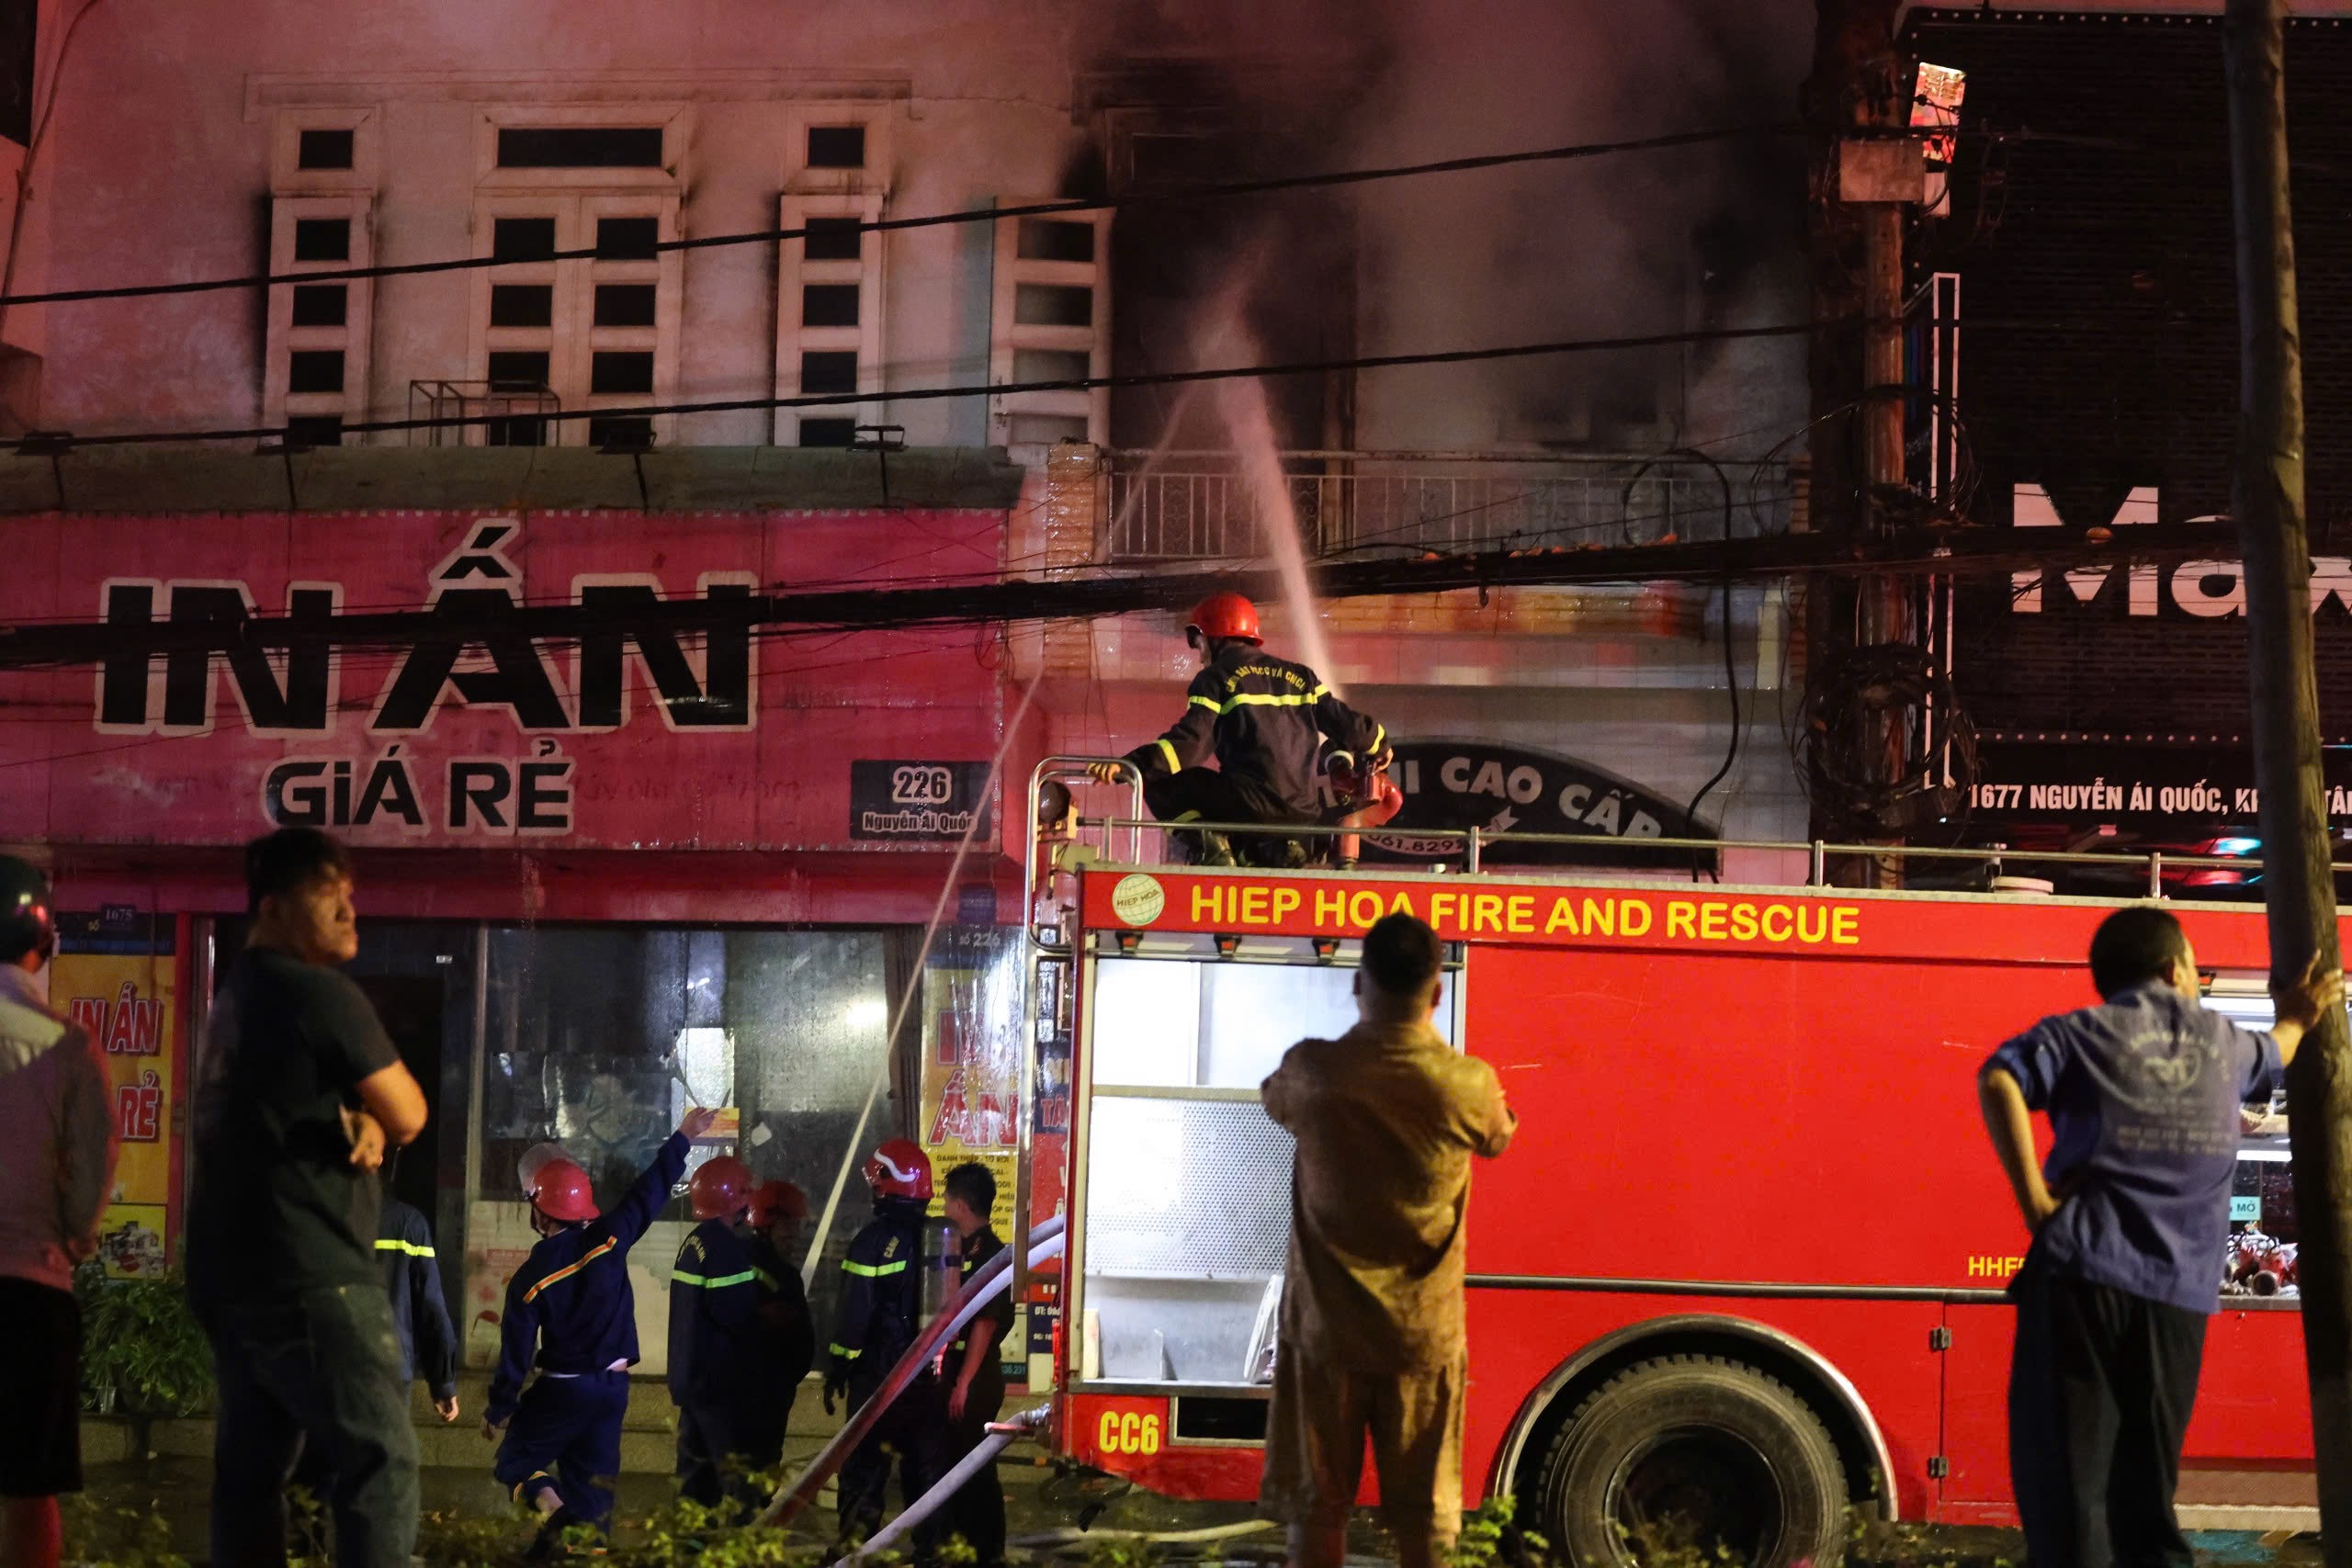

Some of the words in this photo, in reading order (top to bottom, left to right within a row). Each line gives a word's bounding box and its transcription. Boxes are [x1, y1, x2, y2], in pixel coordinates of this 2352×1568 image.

[96, 579, 342, 736] IN
[369, 519, 758, 736] ẤN
[445, 739, 577, 833] RẺ
[894, 767, 951, 803] 226
[1441, 756, 1543, 805] CAO
[1968, 784, 2023, 808] 1677
[2030, 777, 2123, 811] NGUYỄN
[2129, 781, 2154, 810] ÁI
[2159, 778, 2229, 816] QUỐC,
[864, 810, 920, 832] Nguyễn
[1117, 897, 1138, 907] HIEP
[1191, 885, 1301, 925] HIEP
[1316, 888, 1415, 929] HOA
[1430, 893, 1536, 933] FIRE
[1545, 897, 1653, 937] AND
[1667, 901, 1860, 944] RESCUE
[972, 932, 1001, 949] 226
[1099, 1410, 1159, 1456] CC6
